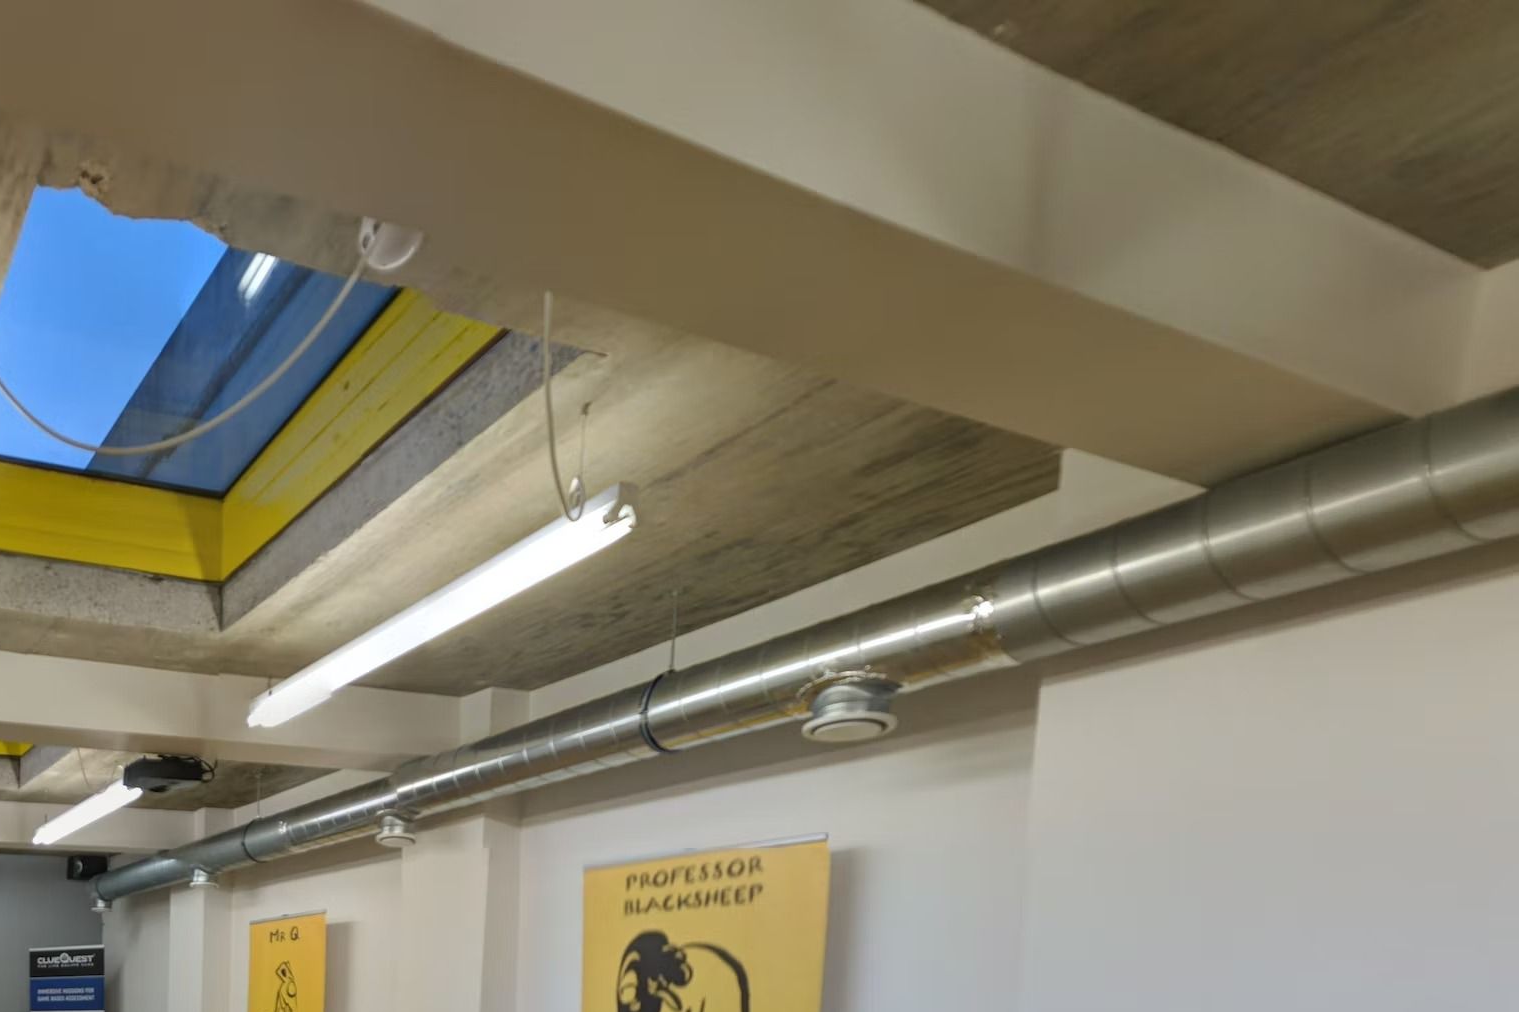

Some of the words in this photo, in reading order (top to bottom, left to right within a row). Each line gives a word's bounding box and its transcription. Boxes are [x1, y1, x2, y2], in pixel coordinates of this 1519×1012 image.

[625, 855, 764, 892] PROFESSOR
[623, 884, 765, 917] BLACKSHEEP
[289, 925, 300, 941] Q
[37, 952, 95, 964] CLUEQUEST
